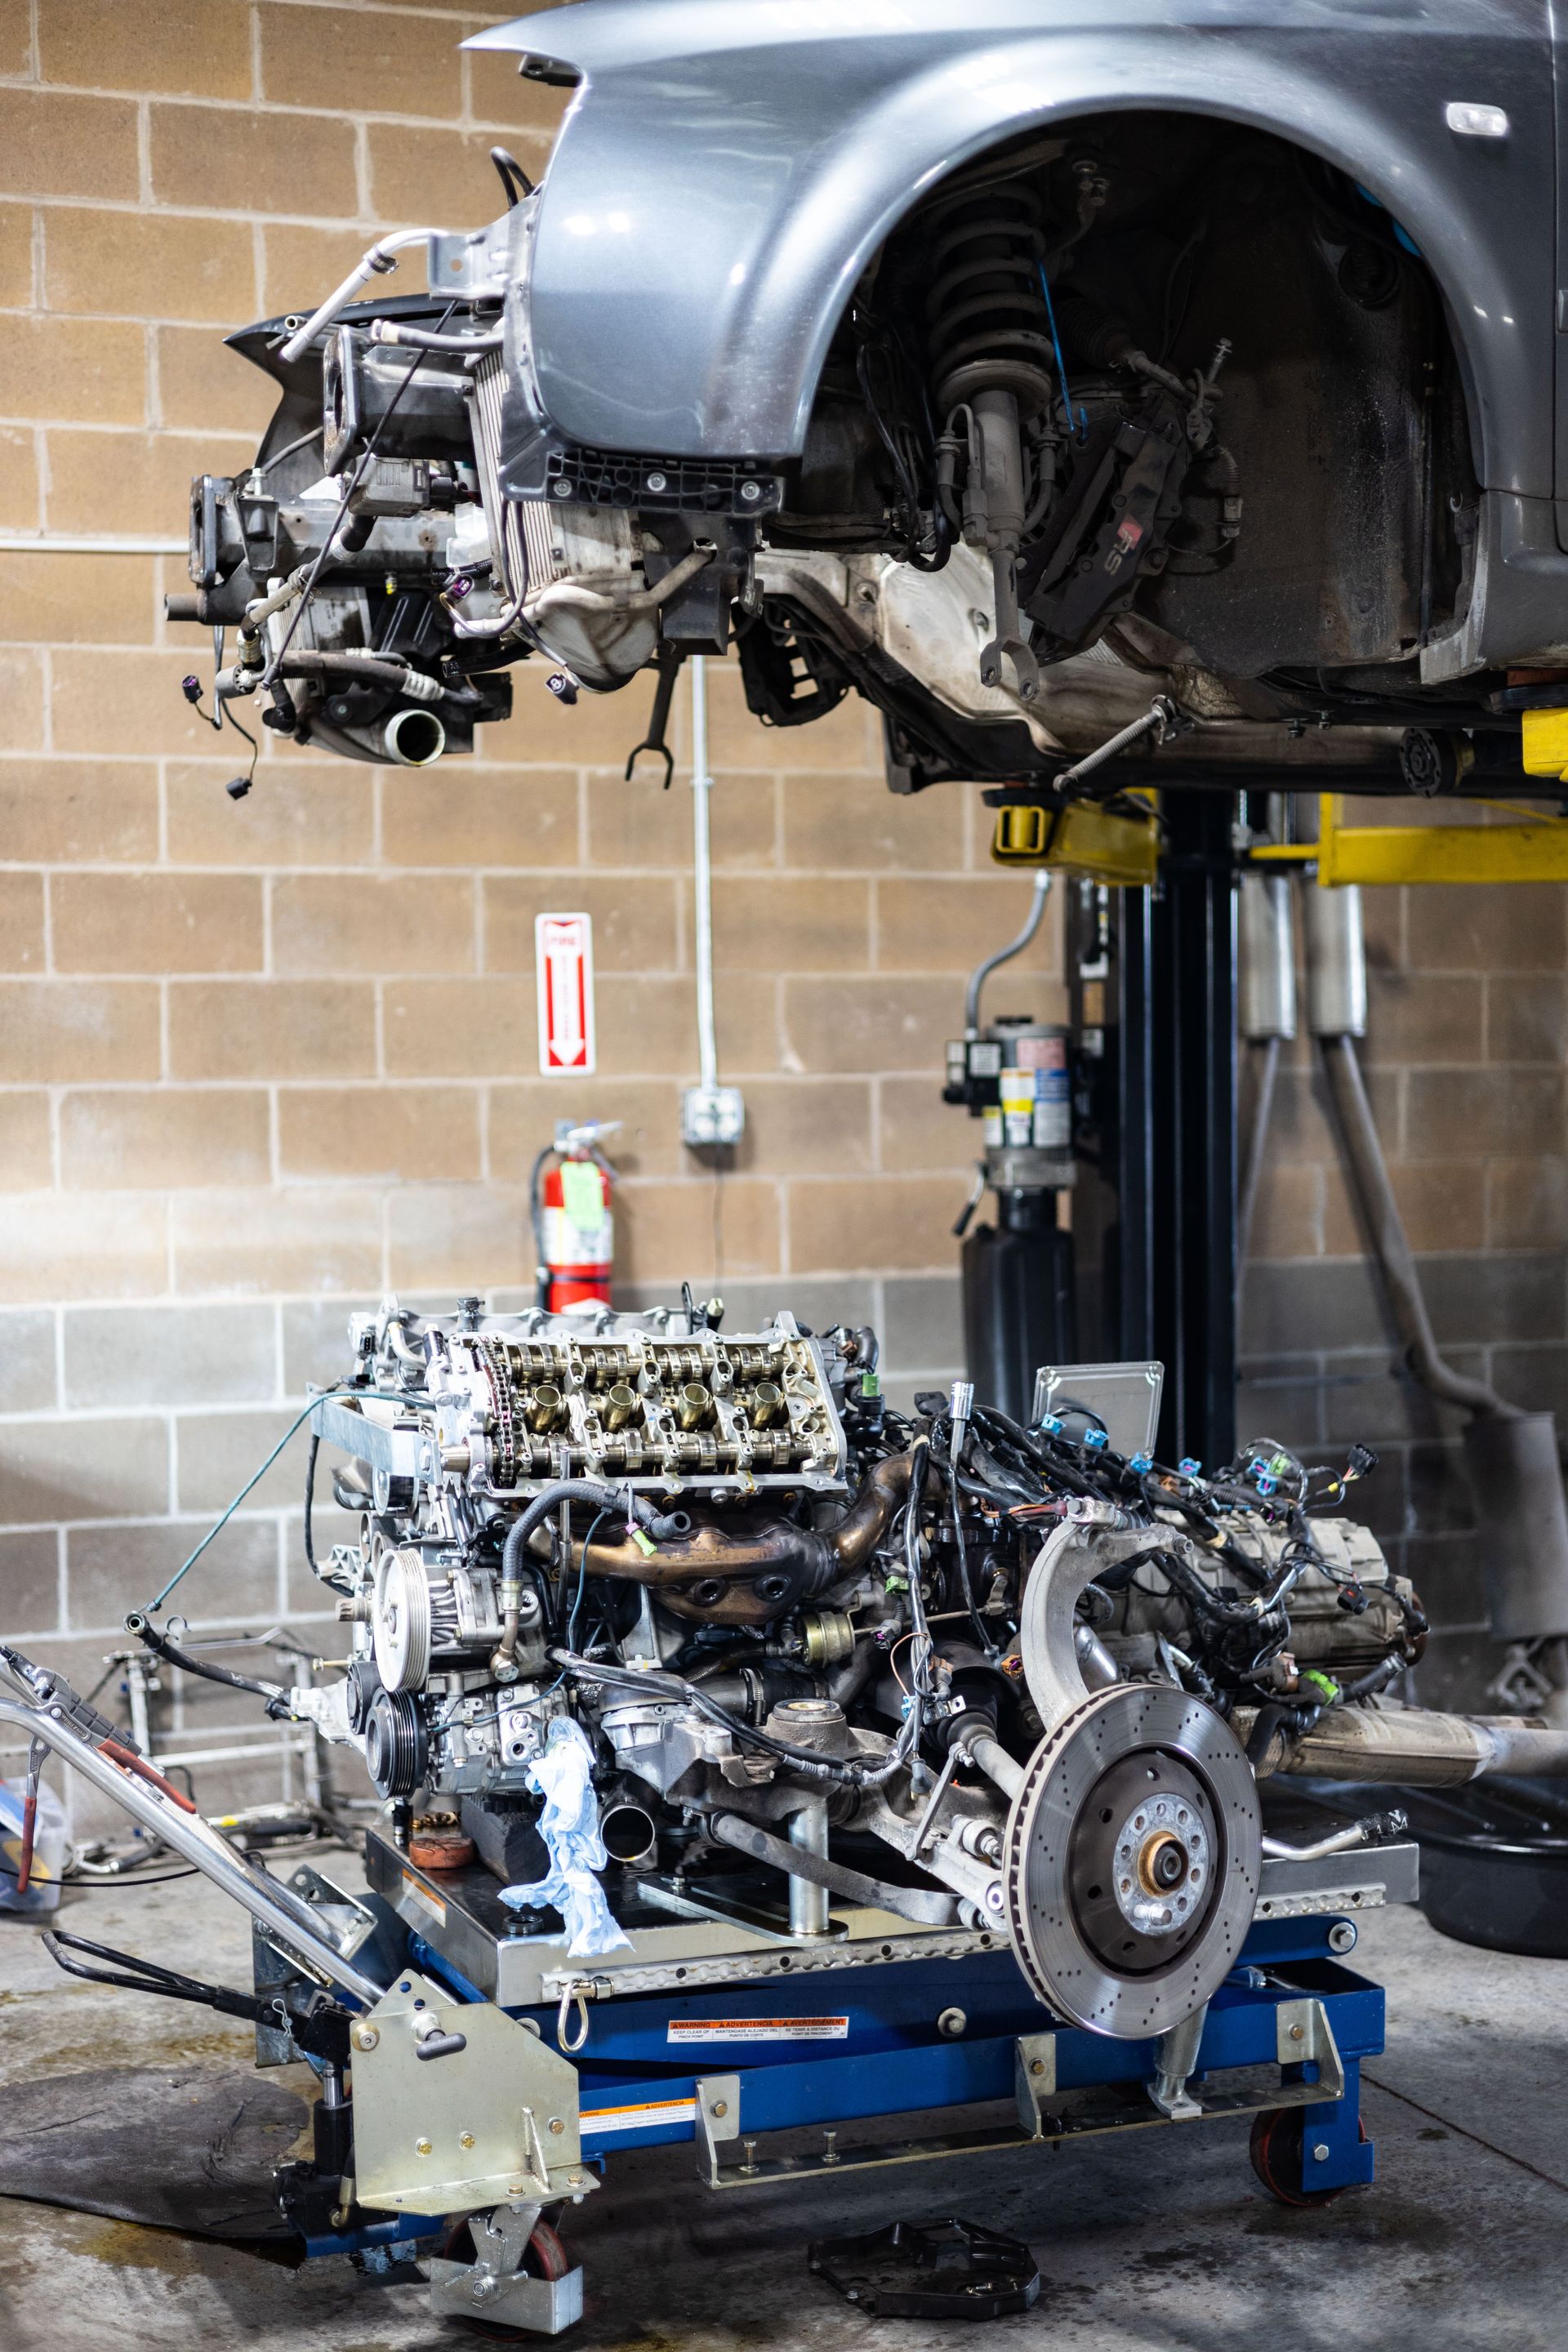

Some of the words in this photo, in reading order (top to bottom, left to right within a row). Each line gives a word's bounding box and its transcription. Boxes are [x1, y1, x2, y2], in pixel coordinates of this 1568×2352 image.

[1104, 528, 1133, 576] RS
[790, 2018, 844, 2026] AVERTISSEMENT
[650, 2100, 684, 2109] ADVERTENCIA
